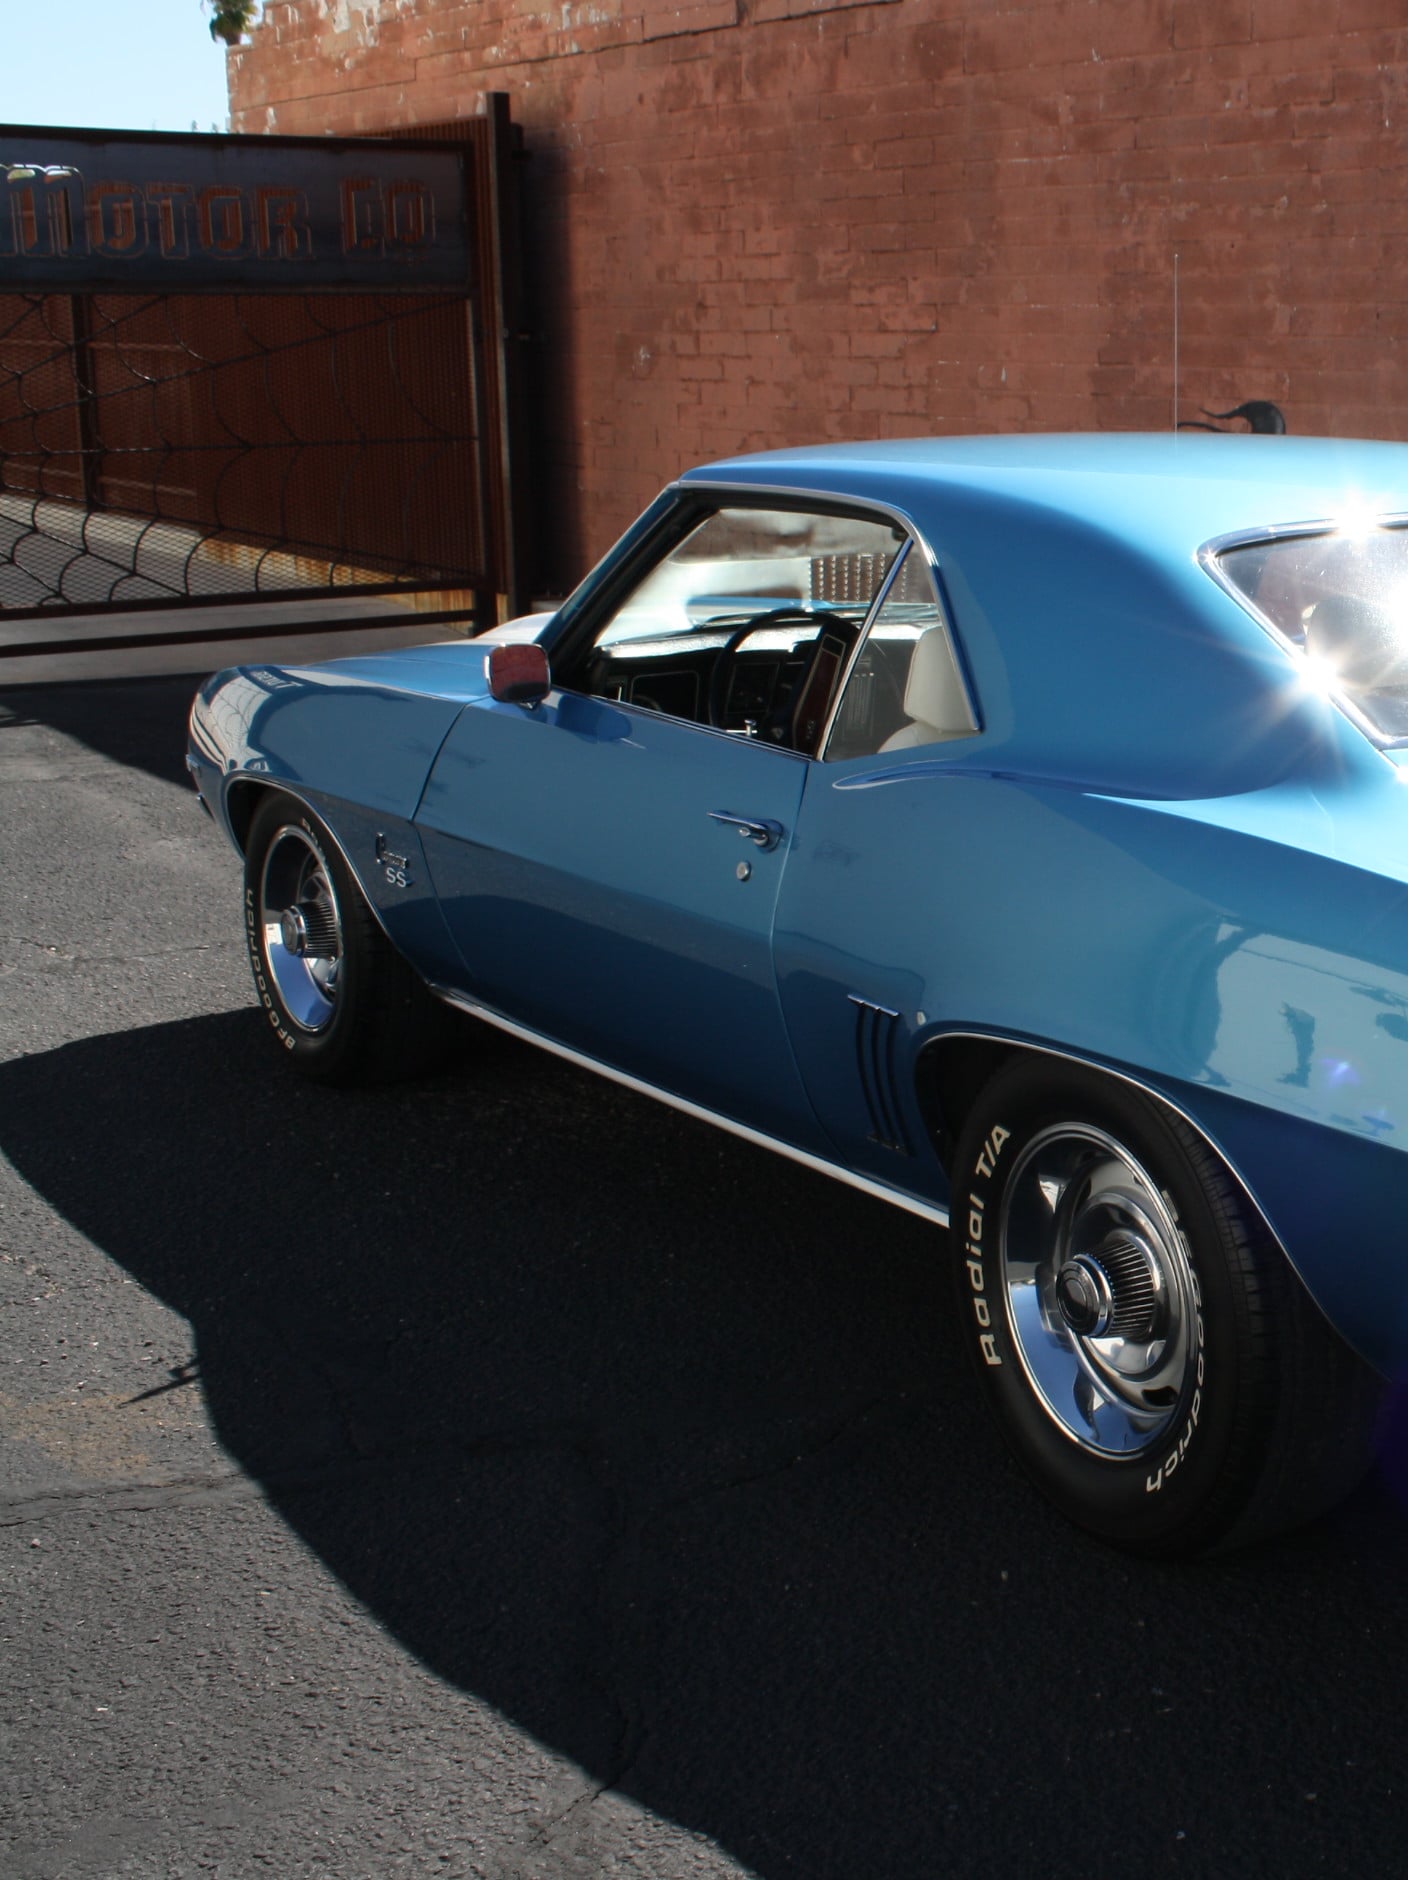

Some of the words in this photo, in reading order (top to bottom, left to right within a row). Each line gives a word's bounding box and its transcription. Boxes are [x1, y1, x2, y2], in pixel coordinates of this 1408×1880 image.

[385, 866, 408, 888] SS
[975, 1124, 1011, 1179] T/A
[966, 1194, 1003, 1367] Radial
